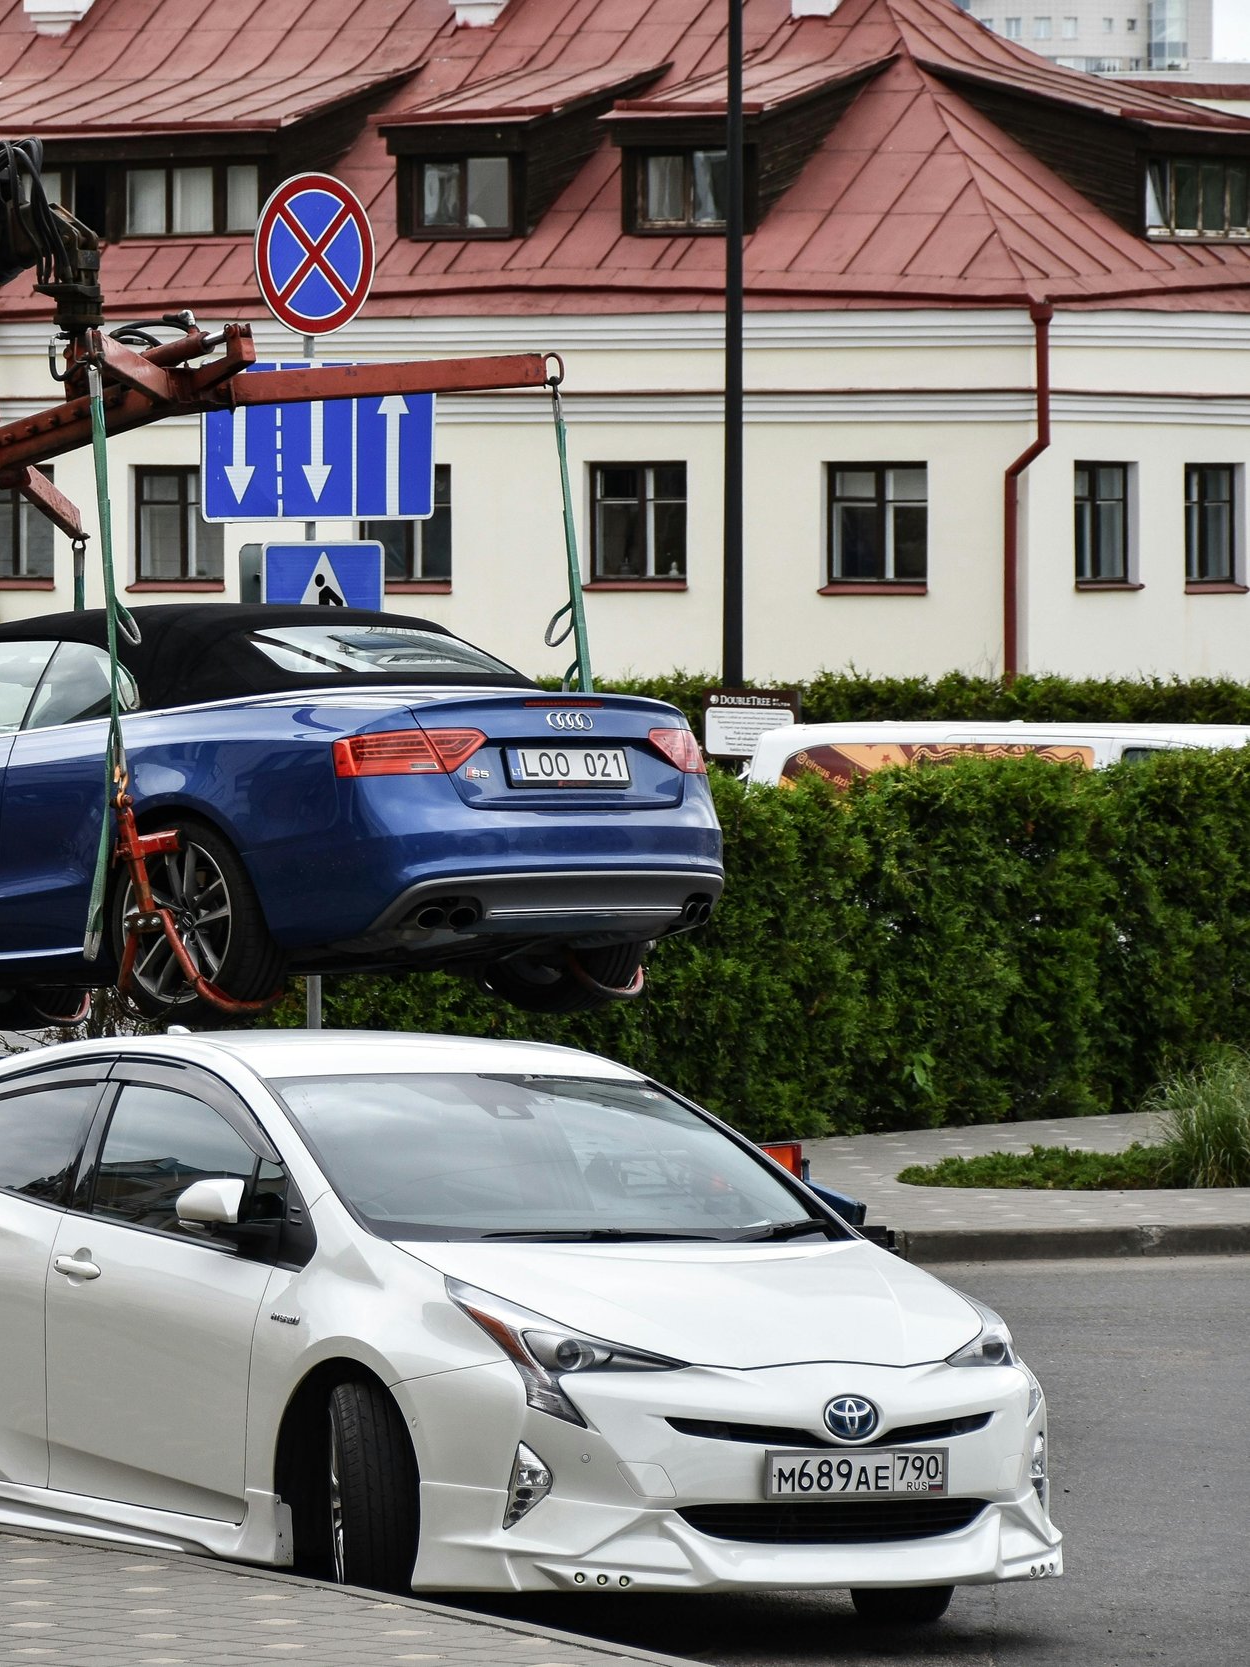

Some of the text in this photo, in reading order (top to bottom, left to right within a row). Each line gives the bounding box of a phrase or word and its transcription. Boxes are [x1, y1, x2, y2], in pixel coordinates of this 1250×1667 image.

[471, 768, 490, 778] S5
[511, 768, 521, 776] LT
[584, 752, 623, 778] 021
[897, 1455, 940, 1480] 790
[906, 1481, 928, 1491] RUS
